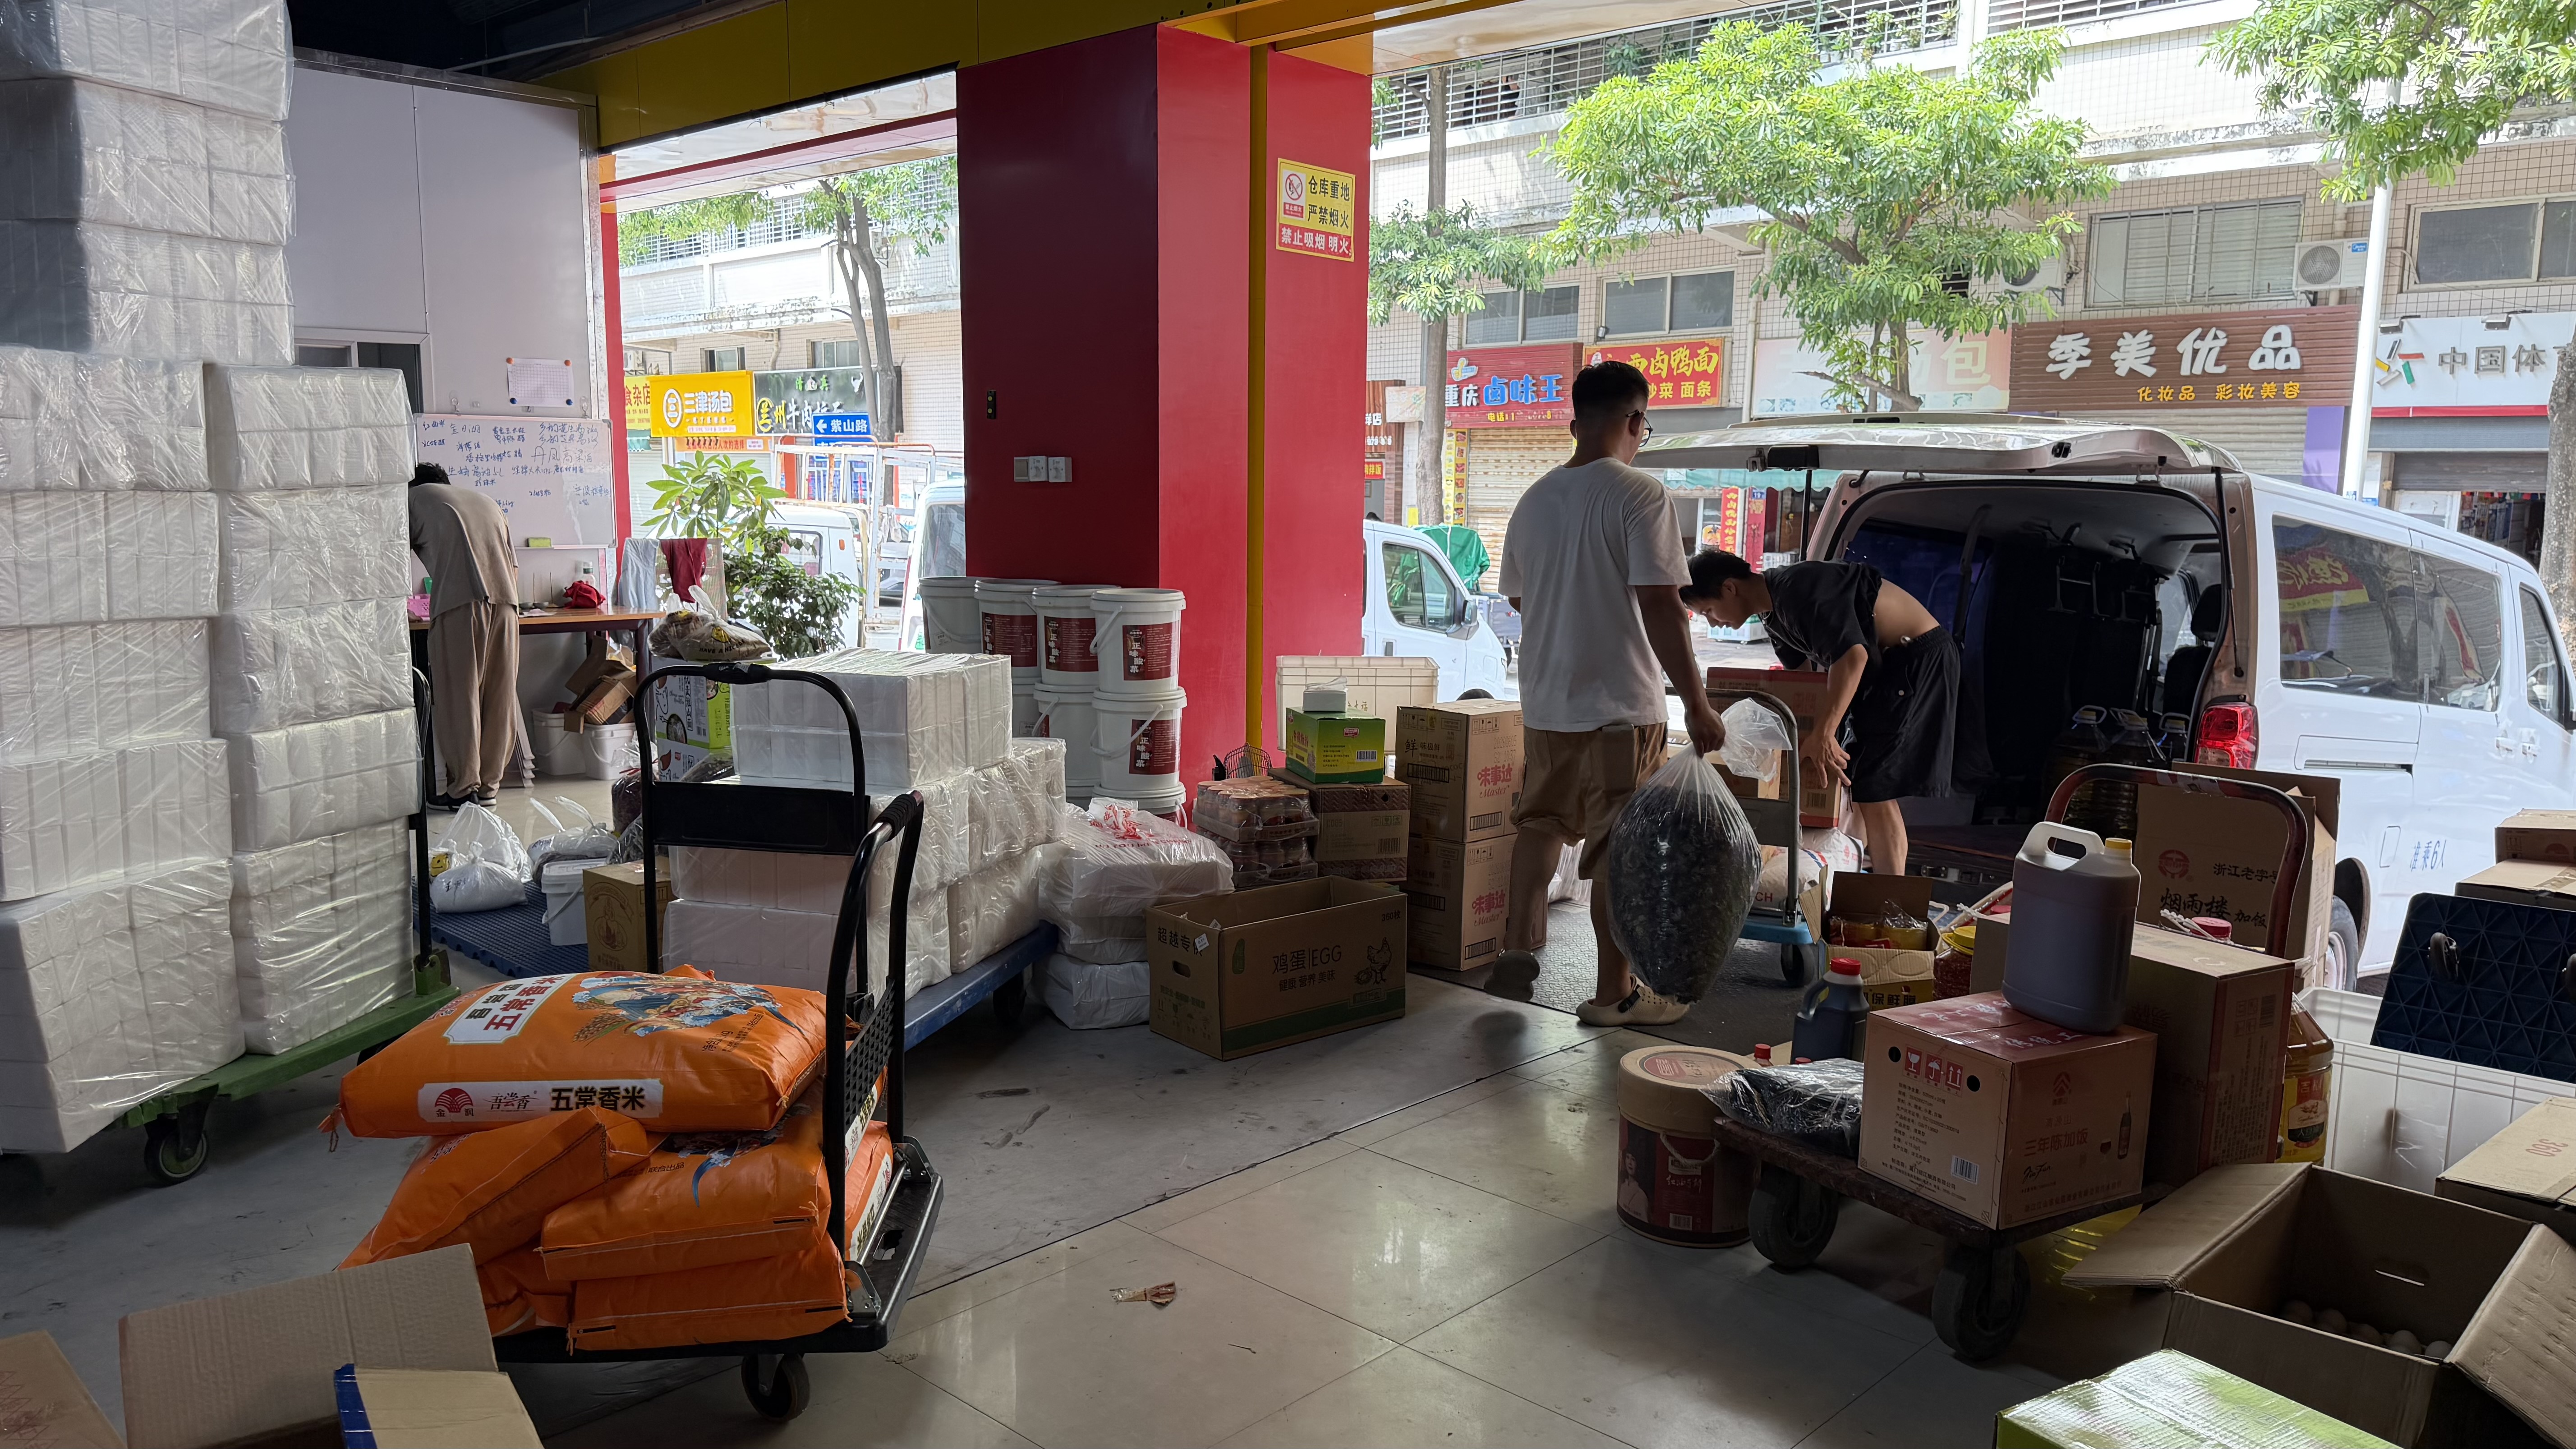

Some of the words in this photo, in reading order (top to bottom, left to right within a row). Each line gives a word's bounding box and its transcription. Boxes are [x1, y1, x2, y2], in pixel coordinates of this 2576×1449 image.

[1308, 175, 1350, 202] 仓库重地
[1307, 204, 1349, 229] 严禁烟火
[1281, 227, 1325, 250] 禁止吸烟
[1328, 236, 1349, 254] 明火
[2045, 324, 2301, 380] 季美优品
[1445, 384, 1479, 406] 重庆
[1483, 373, 1564, 405] 卤味王
[1681, 380, 1711, 398] 面条
[2137, 385, 2195, 402] 化妆品
[2215, 381, 2300, 400] 彩妆美容
[684, 390, 733, 414] 三津汤包
[830, 419, 868, 433] 紫山路
[1405, 738, 1418, 758] 鲜
[1477, 763, 1513, 787] 味事达
[1479, 785, 1510, 799] Master
[2213, 862, 2278, 885] 浙江老字号
[1472, 889, 1506, 915] 味事达
[2160, 887, 2231, 920] 烟雨楼
[2234, 909, 2268, 929] 加饭
[1381, 910, 1401, 922] 360枚
[1474, 912, 1503, 927] Master
[1272, 949, 1306, 975] 鸡蛋
[1312, 945, 1342, 967] EGG
[1279, 979, 1297, 992] 健康
[1298, 973, 1317, 988] 营养
[1318, 970, 1336, 984] 美味
[483, 975, 566, 1031] 五常香米
[549, 1086, 646, 1112] 五常香米
